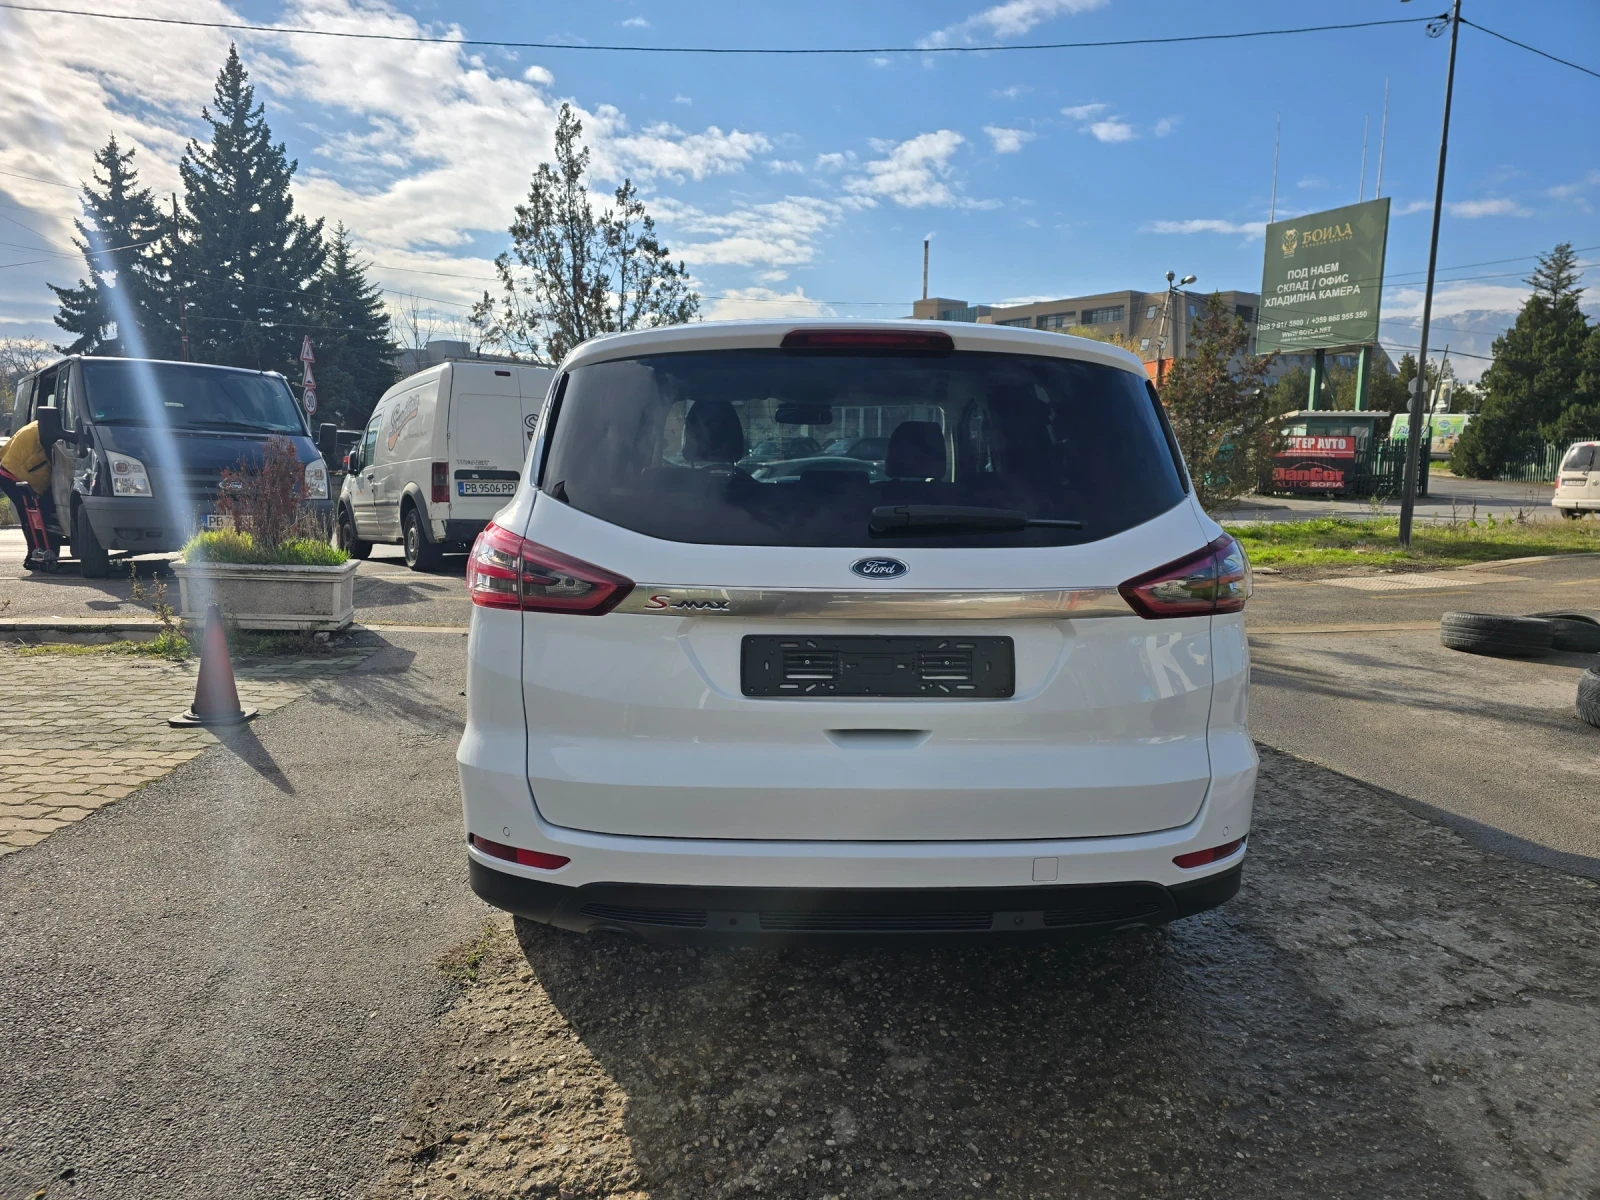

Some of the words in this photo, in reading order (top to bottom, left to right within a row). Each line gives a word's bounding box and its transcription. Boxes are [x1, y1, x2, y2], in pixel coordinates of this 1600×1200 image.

[1287, 267, 1309, 280] ПОД
[1310, 262, 1340, 276] НАЕМ
[1276, 280, 1309, 294] СКЛАД
[1318, 273, 1349, 288] ОФИС
[1264, 291, 1317, 308] ХЛАДИЛНА
[1318, 284, 1361, 300] КАМЕРА
[306, 395, 314, 409] 30
[465, 483, 478, 493] PB
[479, 483, 501, 493] 9506
[502, 483, 514, 493] PP
[863, 560, 896, 574] Ford
[643, 594, 731, 611] S-MAX
